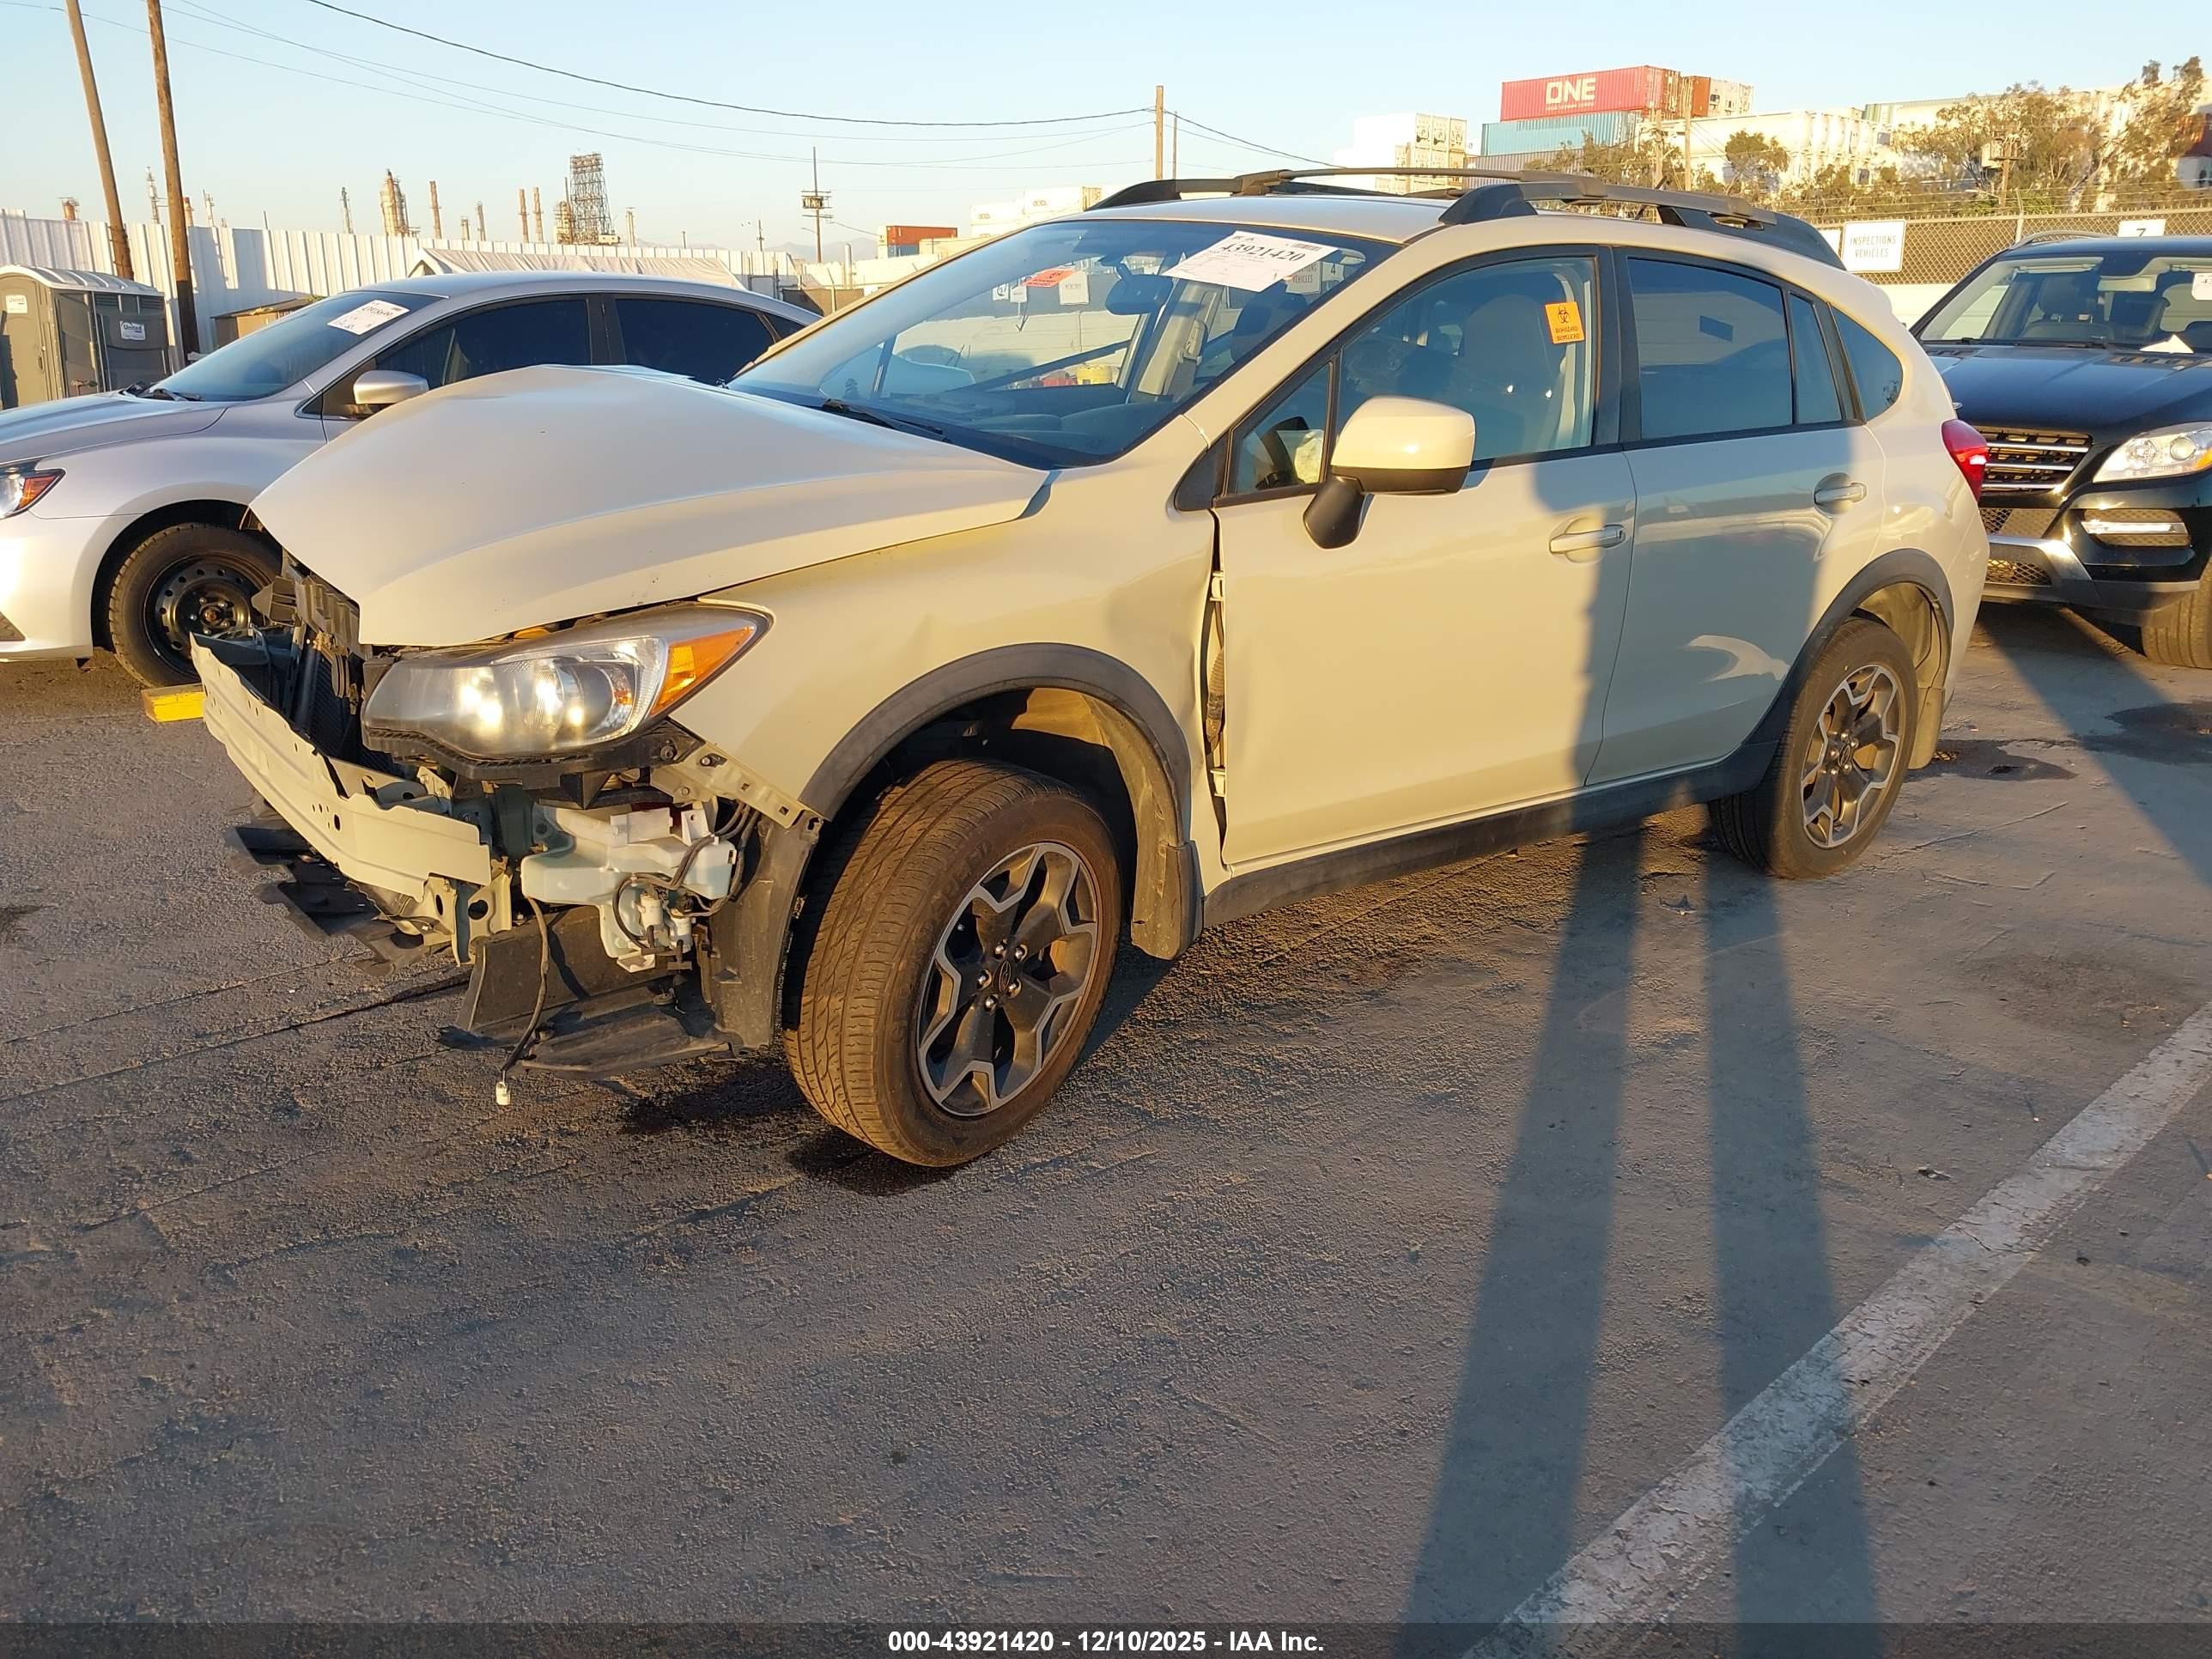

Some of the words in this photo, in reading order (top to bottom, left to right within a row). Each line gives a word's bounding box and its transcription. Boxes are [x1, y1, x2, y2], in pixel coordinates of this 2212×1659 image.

[1545, 77, 1596, 104] ONE
[2136, 228, 2147, 237] 7
[1850, 234, 1897, 246] INSPECTIONS
[1220, 242, 1306, 262] 43921420
[1855, 247, 1889, 258] VEHICLES
